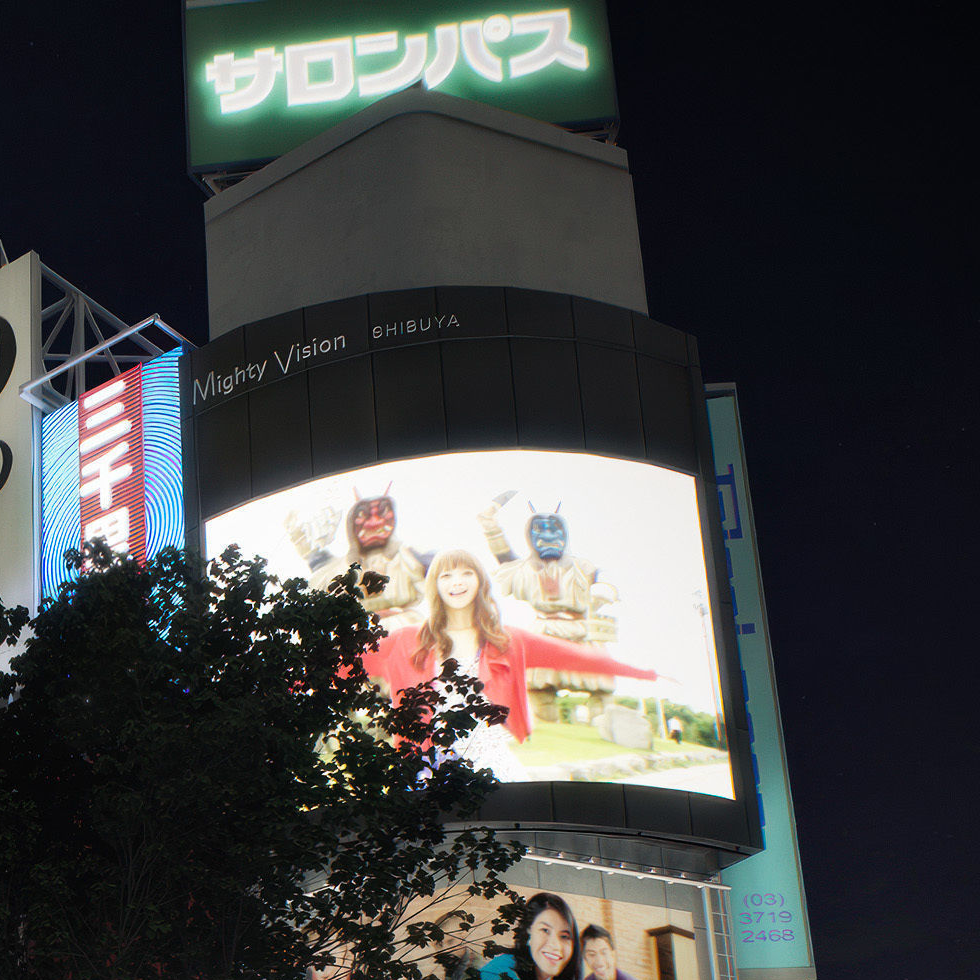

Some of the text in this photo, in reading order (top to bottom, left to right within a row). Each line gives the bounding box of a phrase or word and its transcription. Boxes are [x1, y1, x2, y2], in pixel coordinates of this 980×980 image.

[205, 8, 590, 115] サロンパス
[193, 314, 460, 405] Mighty Vision SHIBUYA
[743, 893, 784, 909] (03)
[739, 911, 793, 925] 3719
[741, 929, 795, 943] 2468
